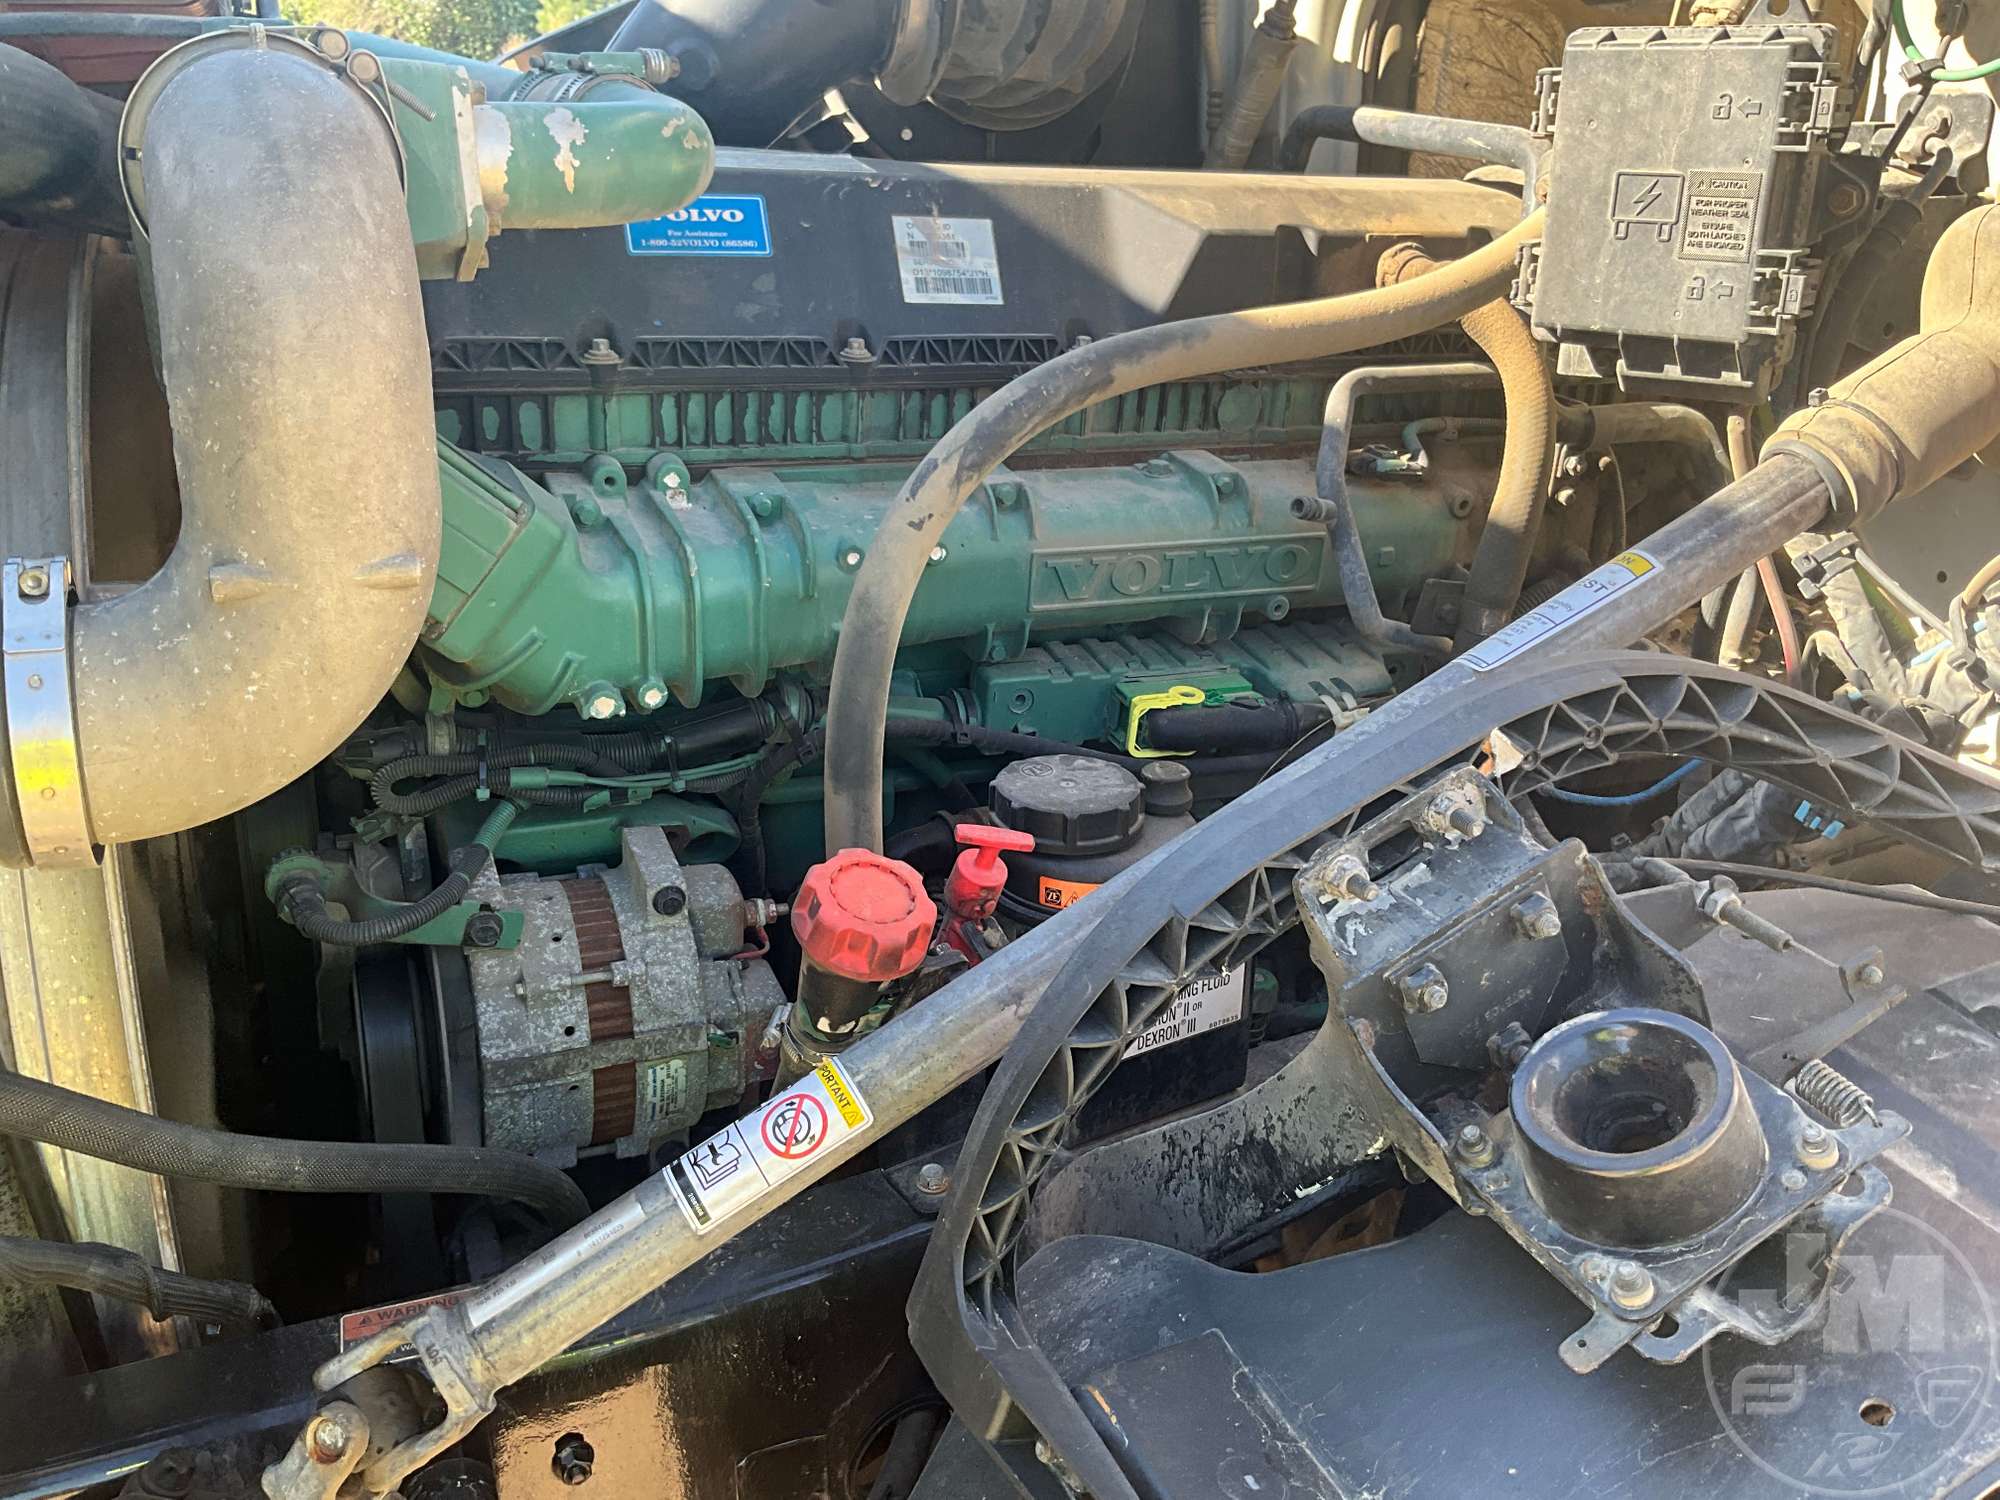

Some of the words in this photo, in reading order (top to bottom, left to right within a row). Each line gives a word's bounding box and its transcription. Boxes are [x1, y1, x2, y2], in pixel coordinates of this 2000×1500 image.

[1712, 181, 1748, 189] CAUTION
[1714, 200, 1747, 208] PROPER
[655, 208, 744, 222] OLVO
[1691, 209, 1728, 217] WEATHER
[1687, 231, 1709, 239] BOTH
[1711, 231, 1746, 241] LATCHES
[1687, 240, 1703, 248] ARE
[1705, 241, 1744, 251] ENGAGED
[1045, 544, 1311, 600] VOLVO
[1202, 975, 1231, 993] FLUID
[1192, 1001, 1202, 1011] OR
[820, 1064, 852, 1110] PORTANT
